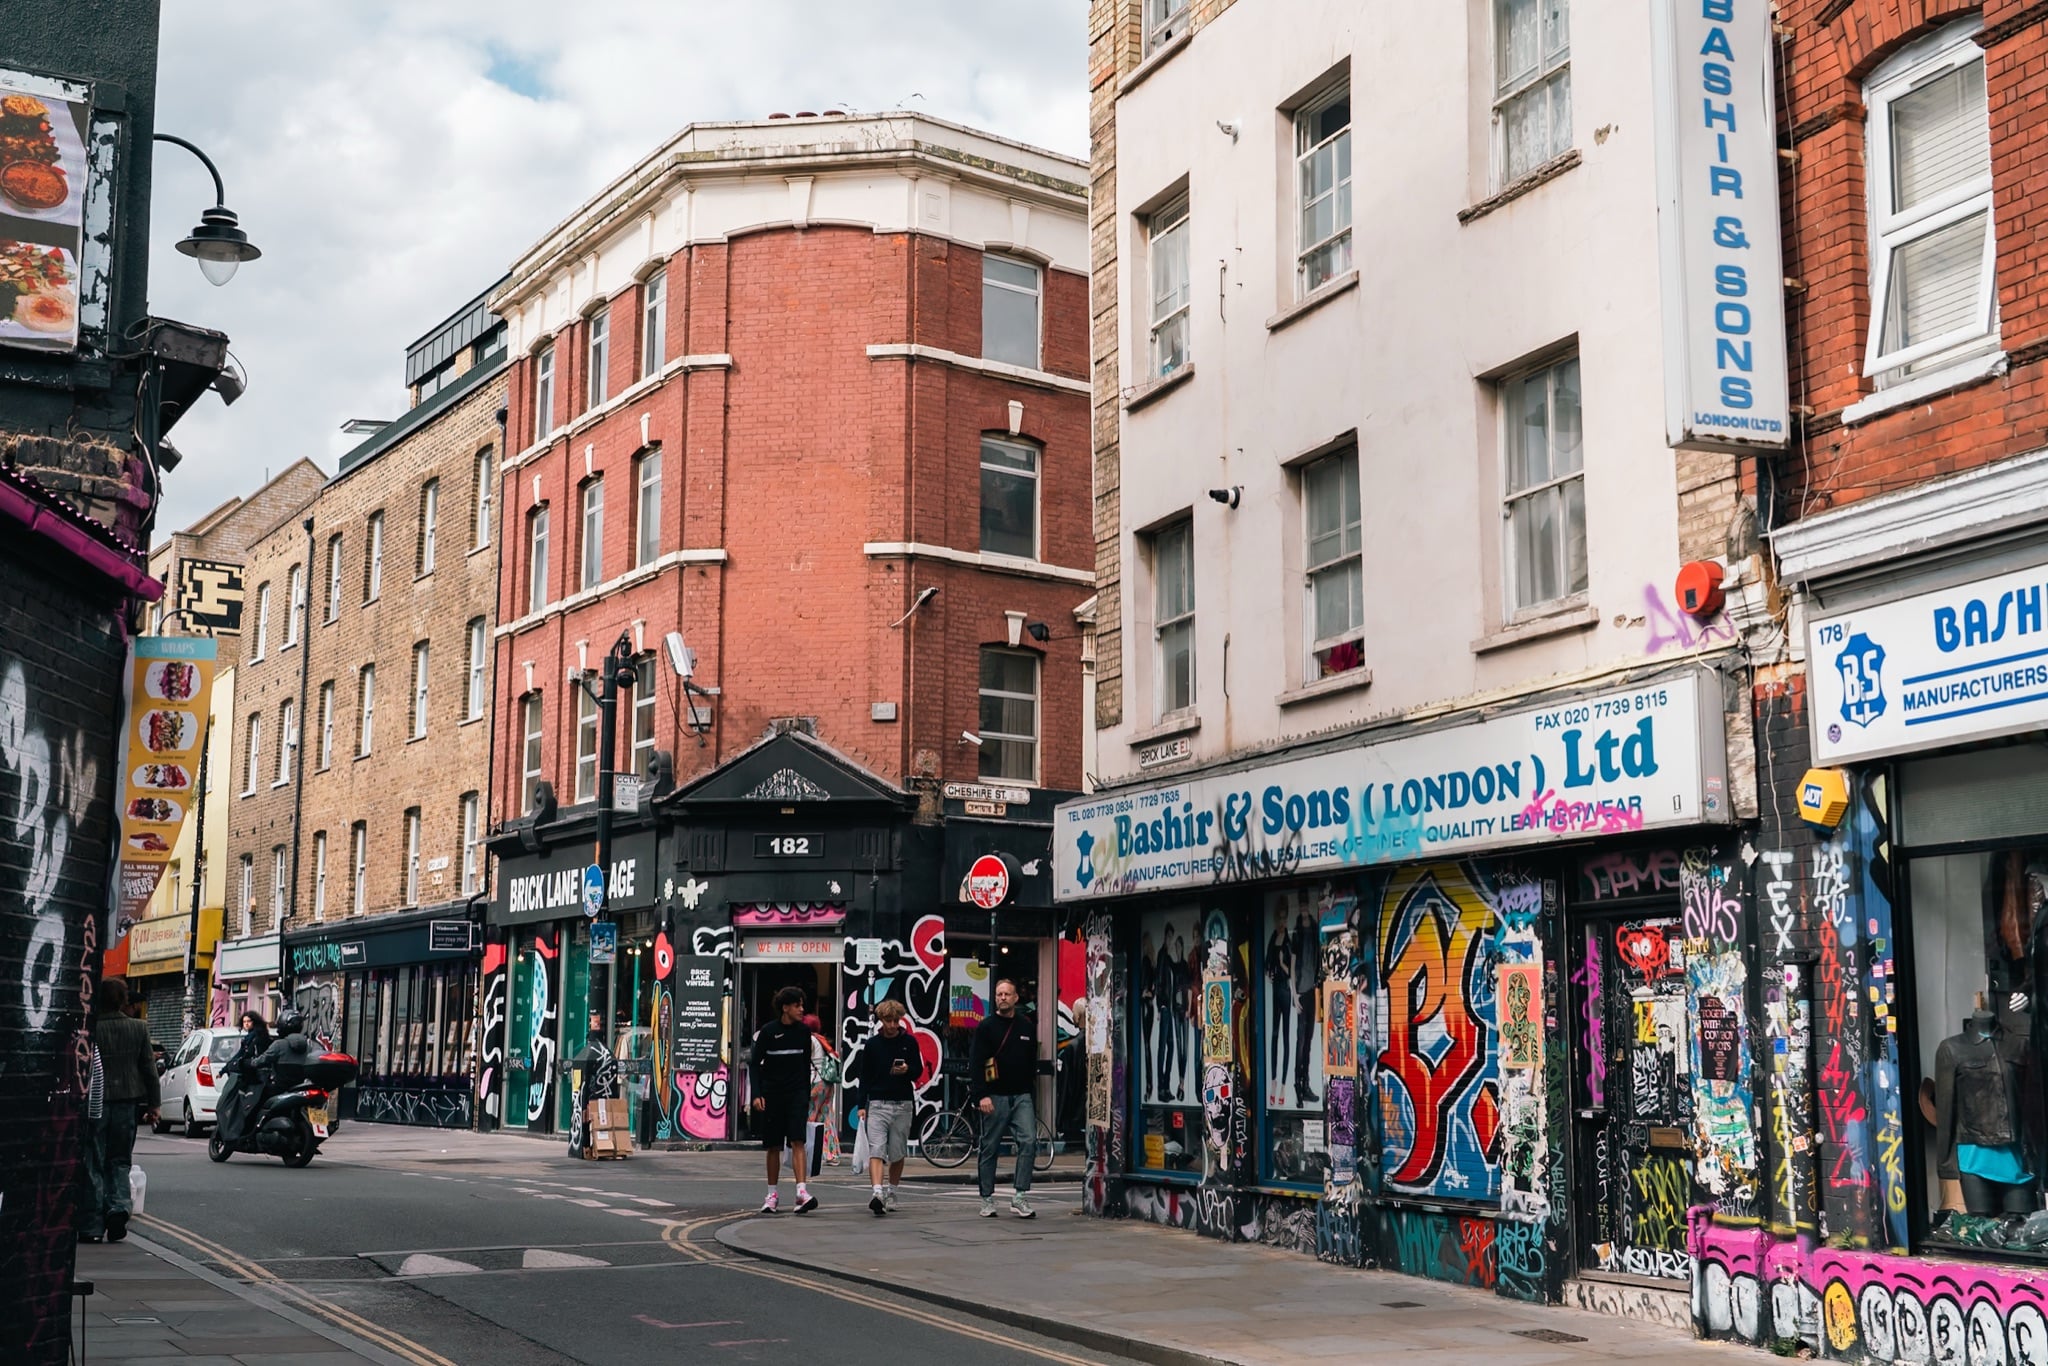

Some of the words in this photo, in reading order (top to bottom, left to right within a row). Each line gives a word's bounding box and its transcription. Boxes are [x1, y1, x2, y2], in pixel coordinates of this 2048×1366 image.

[1715, 265, 1753, 408] SONS
[1695, 412, 1749, 429] LONDON
[1933, 583, 2048, 653] BASH
[161, 642, 195, 654] WRAPS
[1903, 664, 2048, 711] MANUFACTURERS
[1535, 712, 1561, 731] FAX
[1564, 707, 1589, 726] 020
[1594, 698, 1630, 720] 7739
[1635, 690, 1668, 711] 8115
[1141, 749, 1160, 765] BRICK
[1161, 744, 1179, 760] LANE
[616, 776, 639, 785] CCTV
[1114, 801, 1213, 858] Bashir
[1223, 790, 1251, 841] &
[1262, 784, 1350, 836] Sons
[1561, 714, 1659, 789] Ltd
[948, 785, 992, 799] CHESHIRE
[1804, 788, 1822, 806] ADT
[1068, 811, 1081, 822] TEL
[1082, 807, 1096, 820] 020
[1097, 803, 1114, 818] 7739
[1115, 800, 1134, 814] 0834
[1140, 795, 1158, 809] 7729
[770, 838, 809, 854] 182
[1124, 856, 1224, 883] MANUFACTURERS
[1427, 817, 1496, 843] QUALITY
[510, 873, 545, 913] BRICK
[546, 867, 579, 908] LANE
[757, 942, 772, 953] WE
[777, 942, 796, 953] ARE
[801, 942, 831, 953] OPEN!
[690, 968, 711, 976] BRICK
[316, 1124, 325, 1134] L
